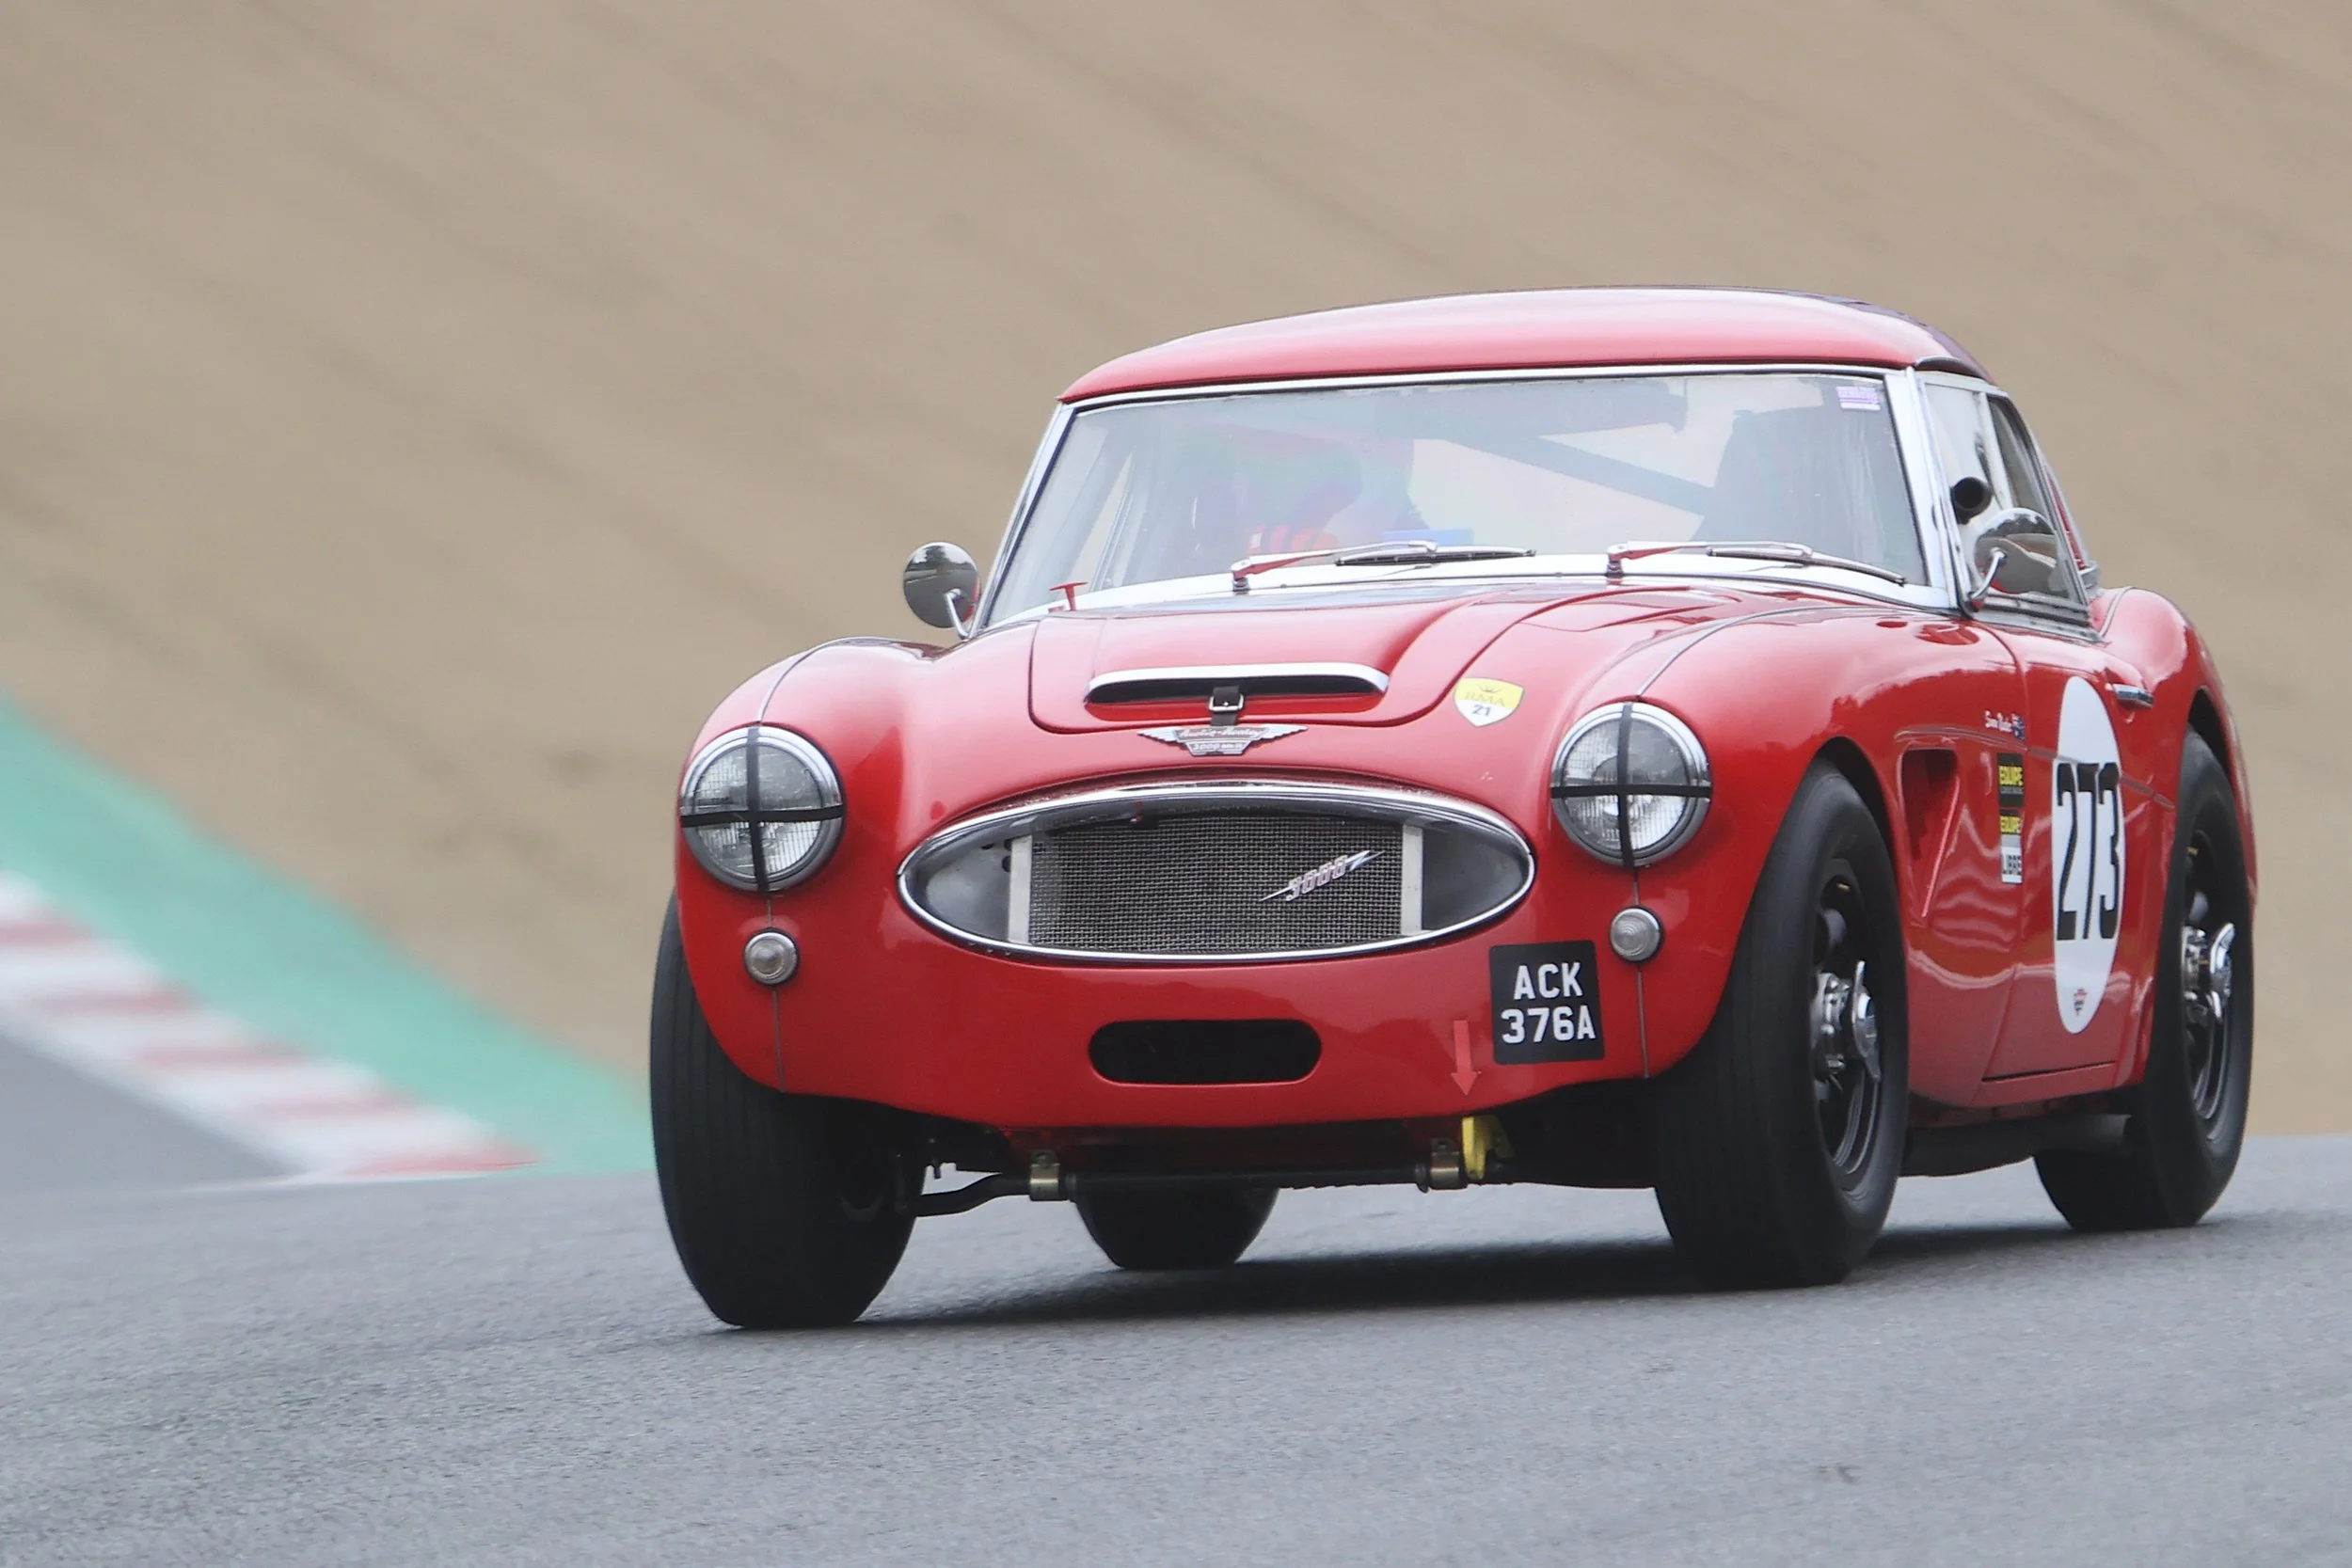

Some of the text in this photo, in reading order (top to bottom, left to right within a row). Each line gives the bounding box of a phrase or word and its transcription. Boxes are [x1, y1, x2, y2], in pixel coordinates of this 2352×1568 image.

[1464, 691, 1505, 707] RMA
[1472, 704, 1492, 717] 21
[2057, 762, 2120, 941] 273
[1285, 854, 1348, 901] 3000
[1514, 962, 1582, 1000] ACK
[1502, 1005, 1596, 1043] 376A
